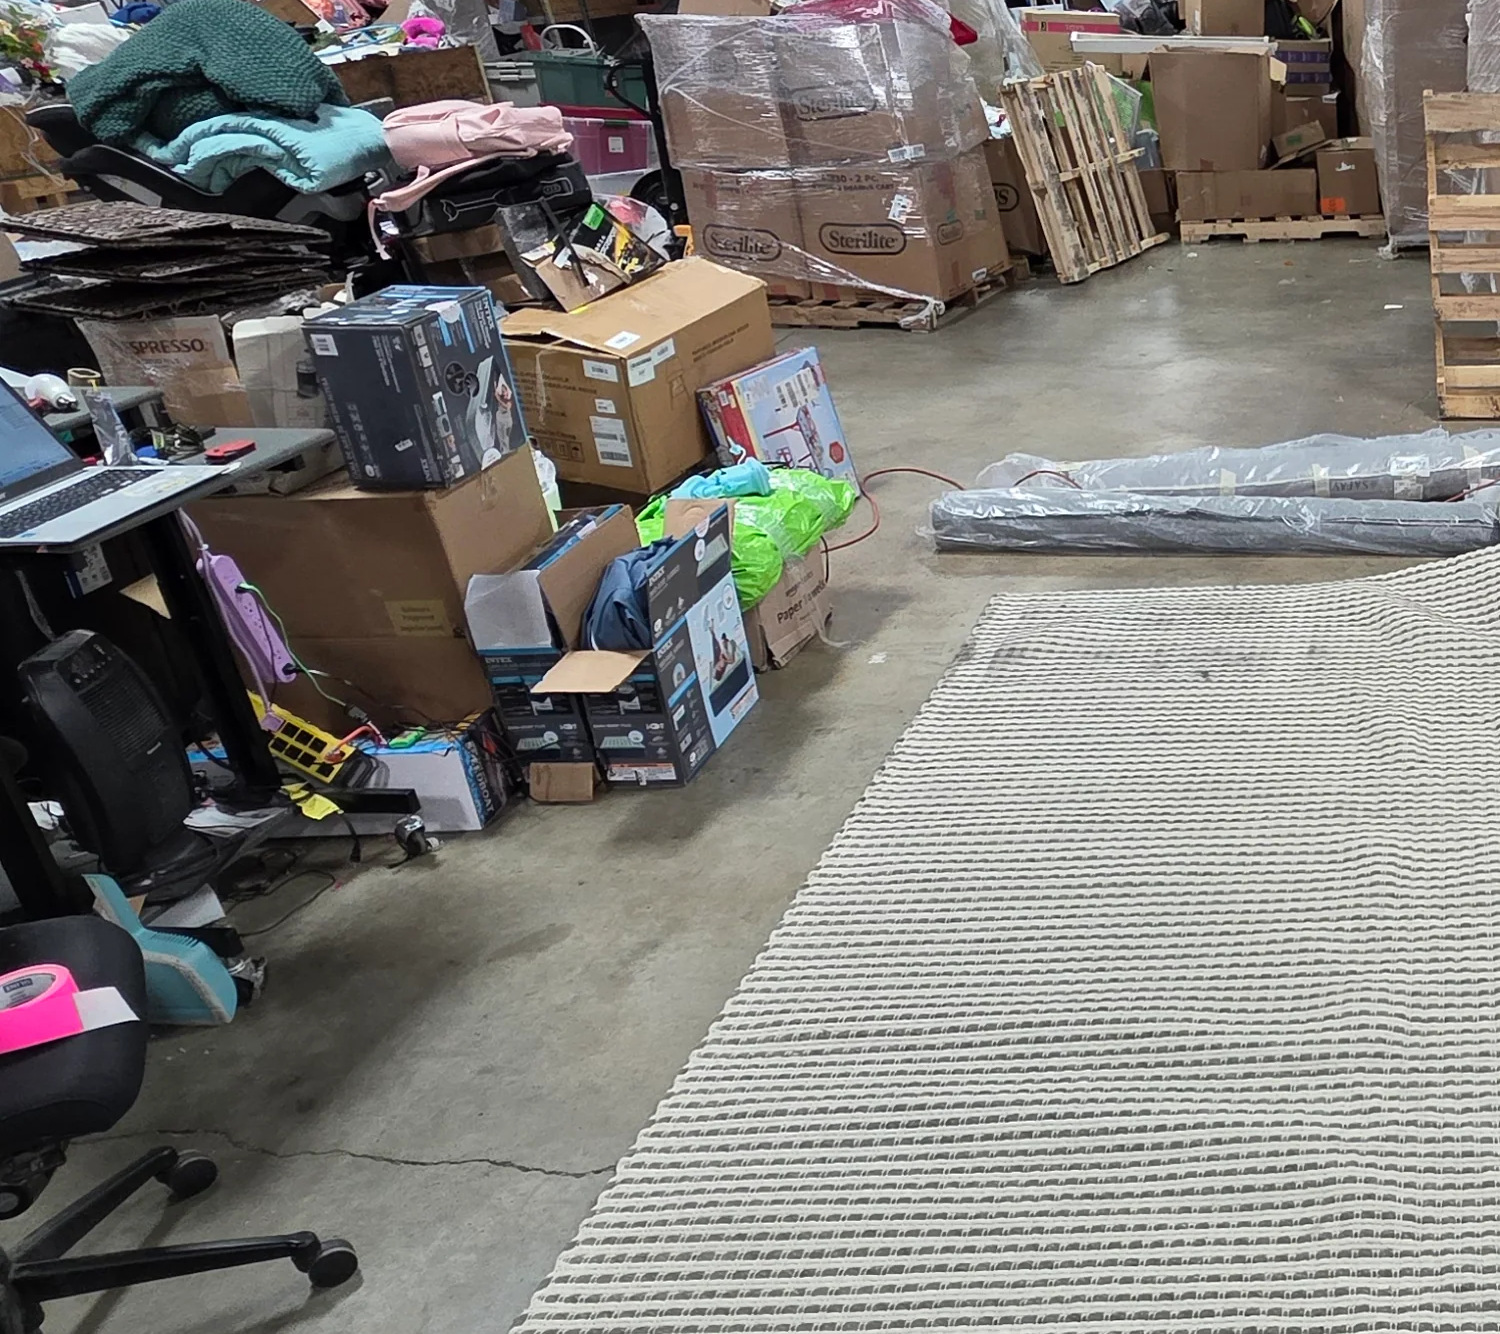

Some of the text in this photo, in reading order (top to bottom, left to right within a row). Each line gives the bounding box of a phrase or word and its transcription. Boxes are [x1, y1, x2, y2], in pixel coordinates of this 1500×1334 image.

[710, 232, 772, 255] Sterilite
[828, 230, 898, 249] Sterilite
[1333, 479, 1369, 492] SAFAV
[777, 600, 802, 624] Paper
[485, 656, 512, 664] INTEX
